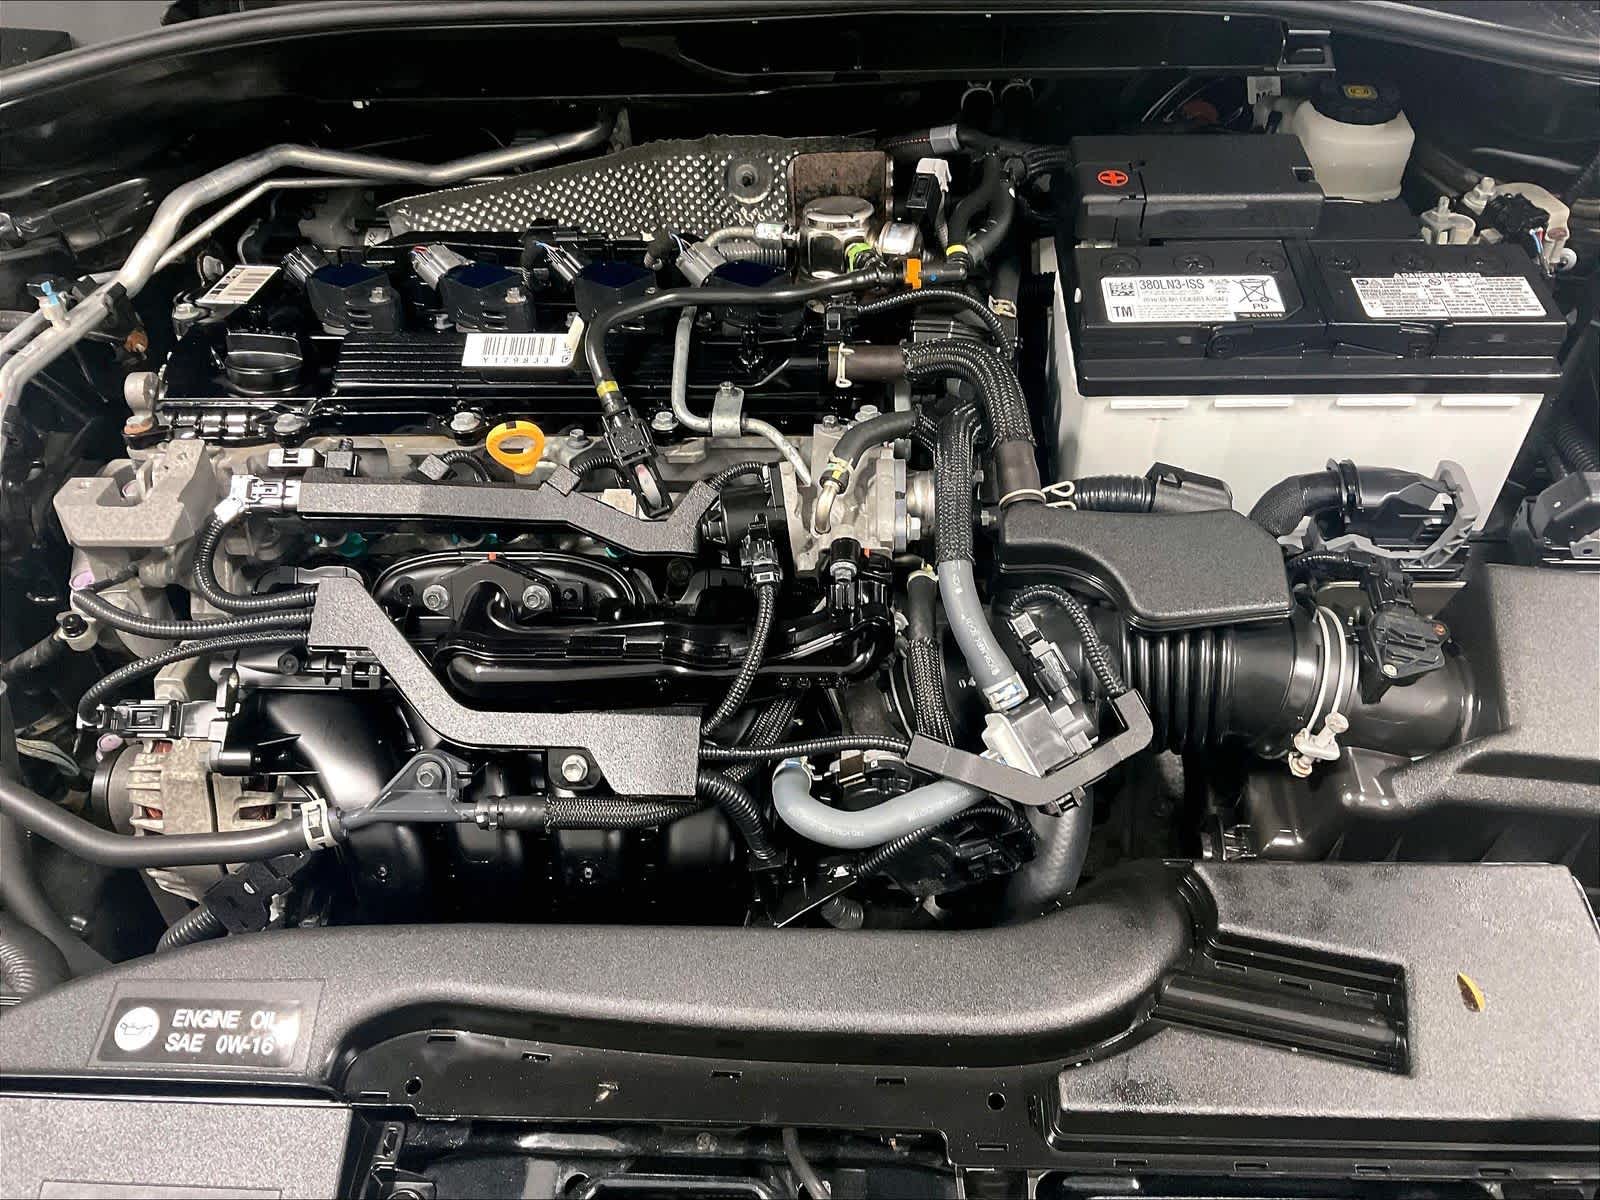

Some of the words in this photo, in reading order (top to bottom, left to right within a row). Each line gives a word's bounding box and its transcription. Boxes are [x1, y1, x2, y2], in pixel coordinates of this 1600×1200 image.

[1139, 279, 1205, 290] 380LN3-ISS
[1113, 306, 1133, 318] TM
[172, 1008, 241, 1029] ENGINE
[250, 1010, 276, 1029] OIL
[164, 1033, 205, 1053] SAE
[215, 1036, 275, 1055] 0W-16
